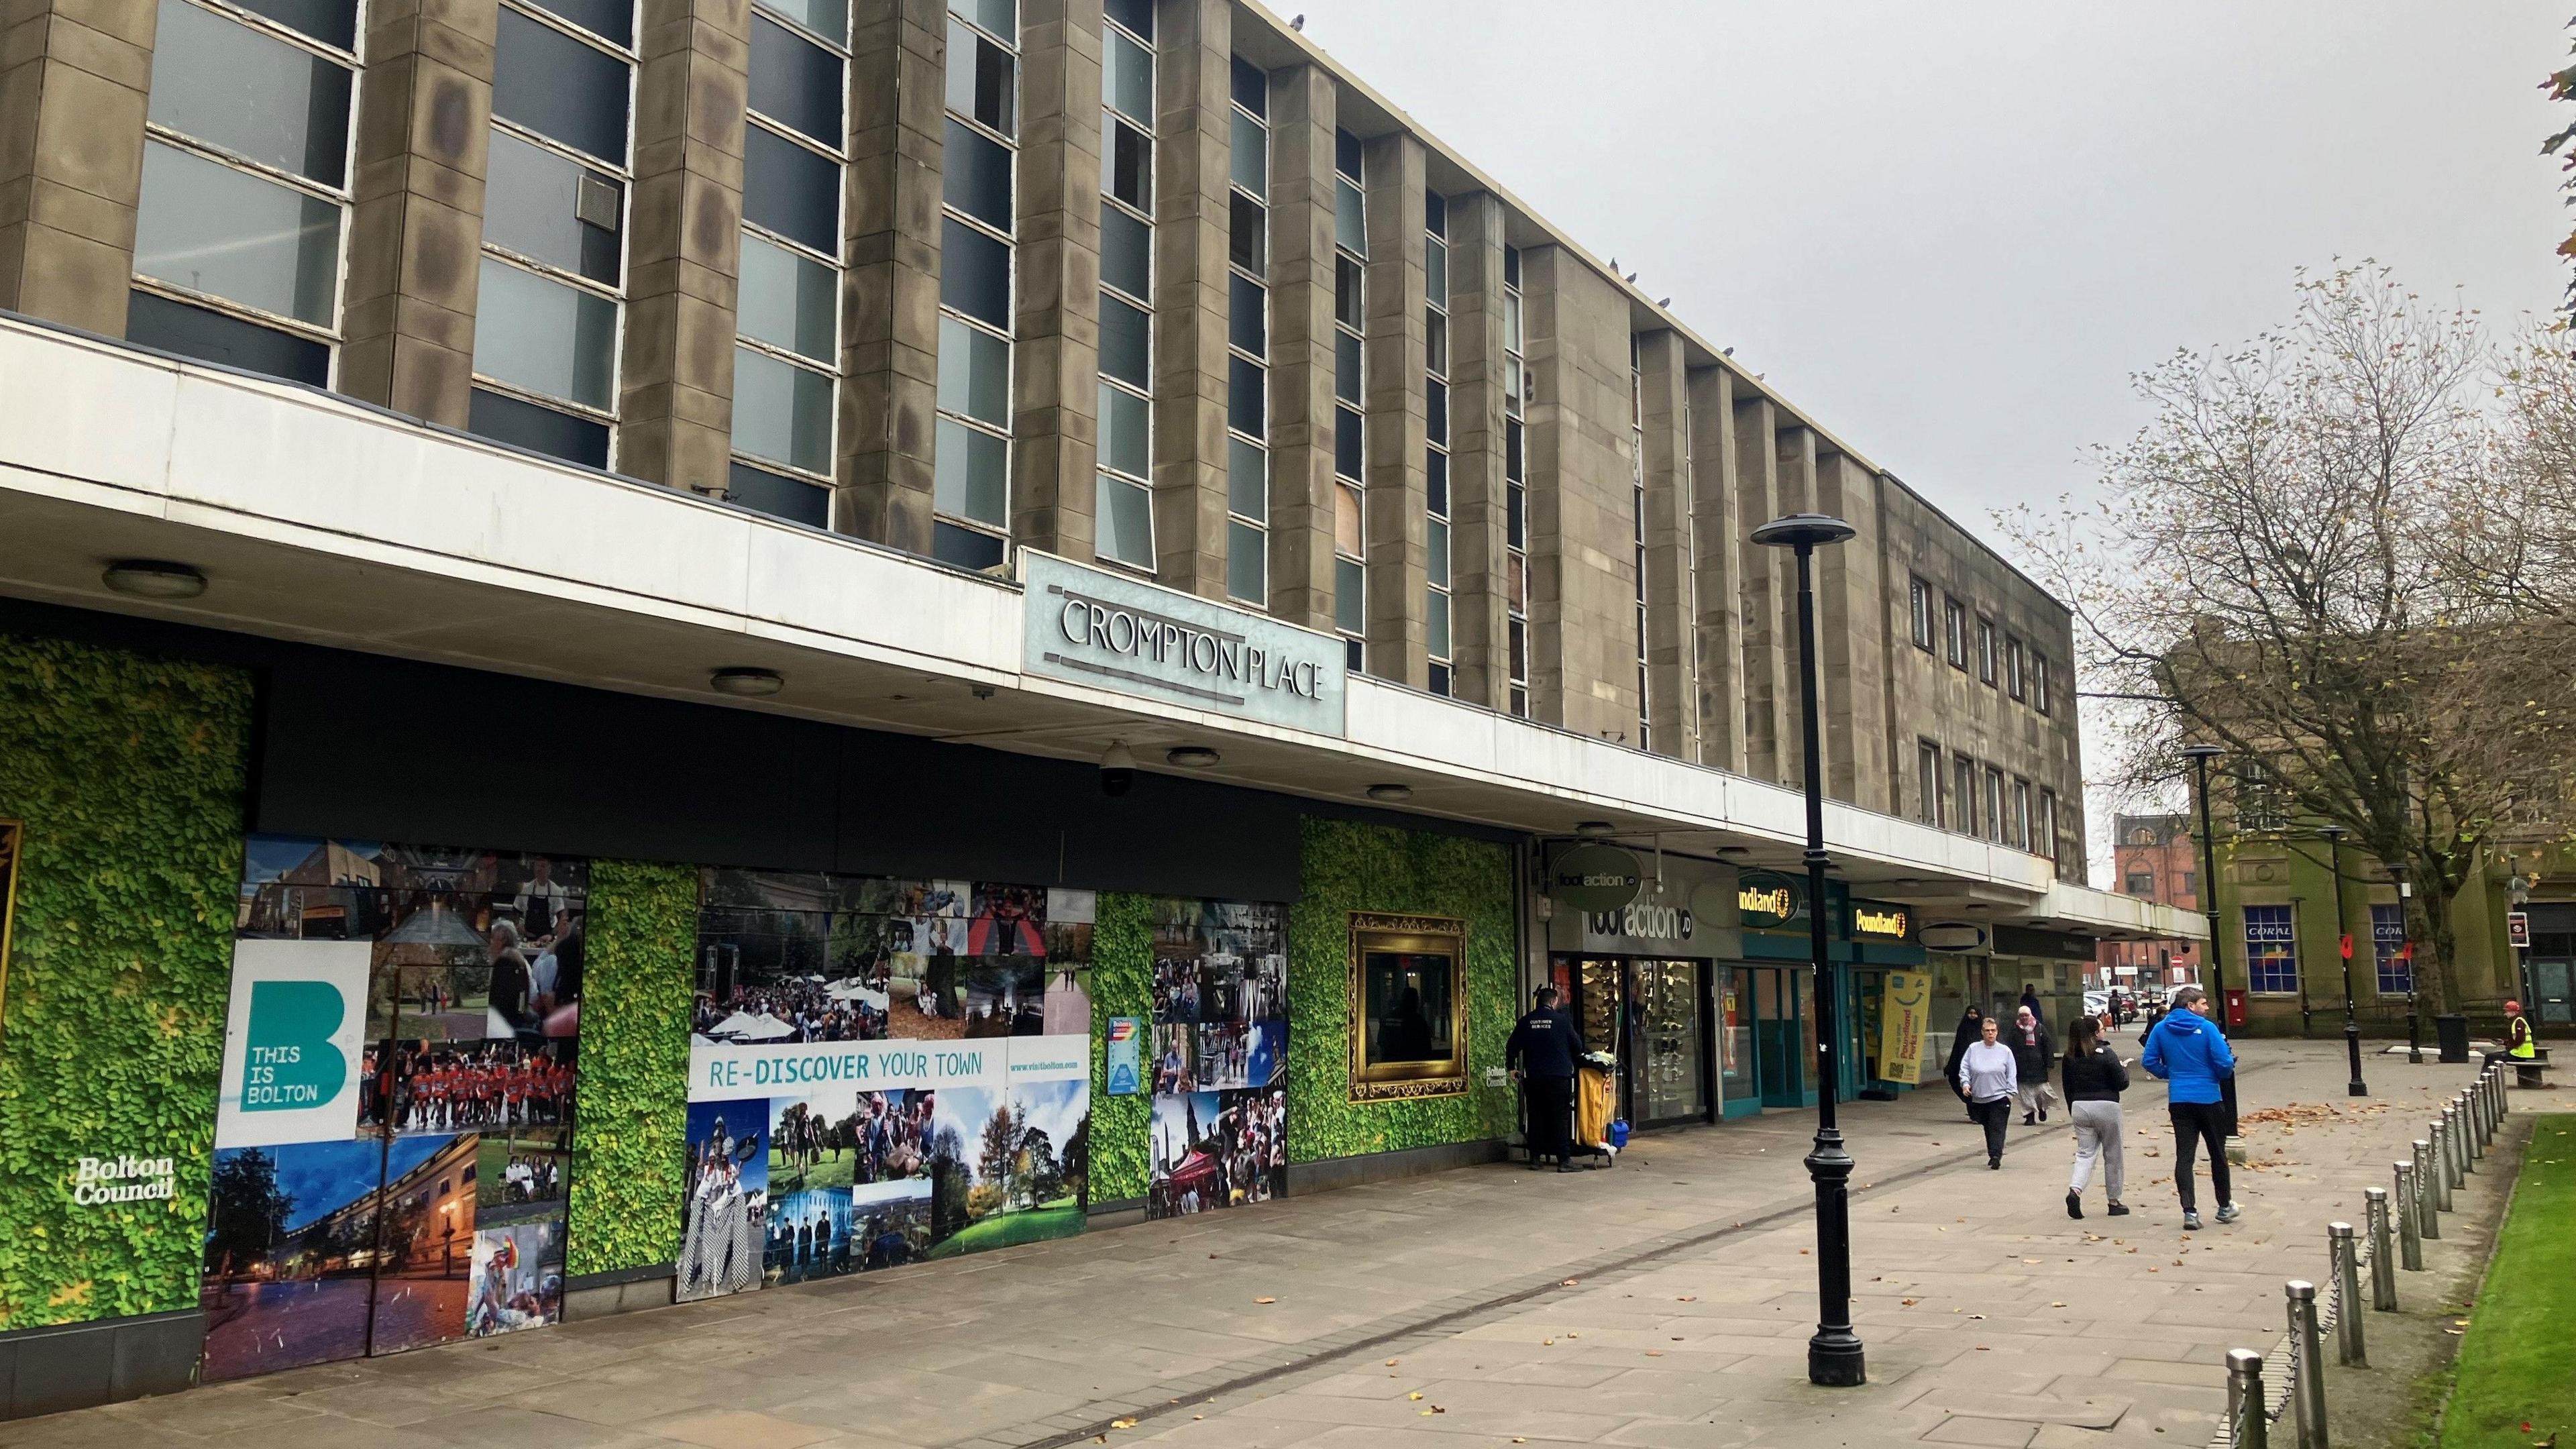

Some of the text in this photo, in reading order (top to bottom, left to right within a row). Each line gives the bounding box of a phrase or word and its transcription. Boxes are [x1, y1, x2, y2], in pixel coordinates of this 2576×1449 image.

[1060, 599, 1326, 701] CROMPTON PLACE
[1559, 872, 1624, 886] footaction
[1856, 909, 1897, 934] Poundland
[2249, 927, 2291, 935] CORAL
[252, 1046, 301, 1064] THIS
[250, 1066, 274, 1084] IS
[710, 1051, 982, 1087] RE-DISCOVER YOUR TOWN
[1010, 1061, 1078, 1072] www.visitbolton.com
[1486, 1065, 1507, 1077] Bolton
[248, 1084, 318, 1104] BOLTON
[77, 1155, 174, 1181] Bolton
[74, 1177, 174, 1205] Council
